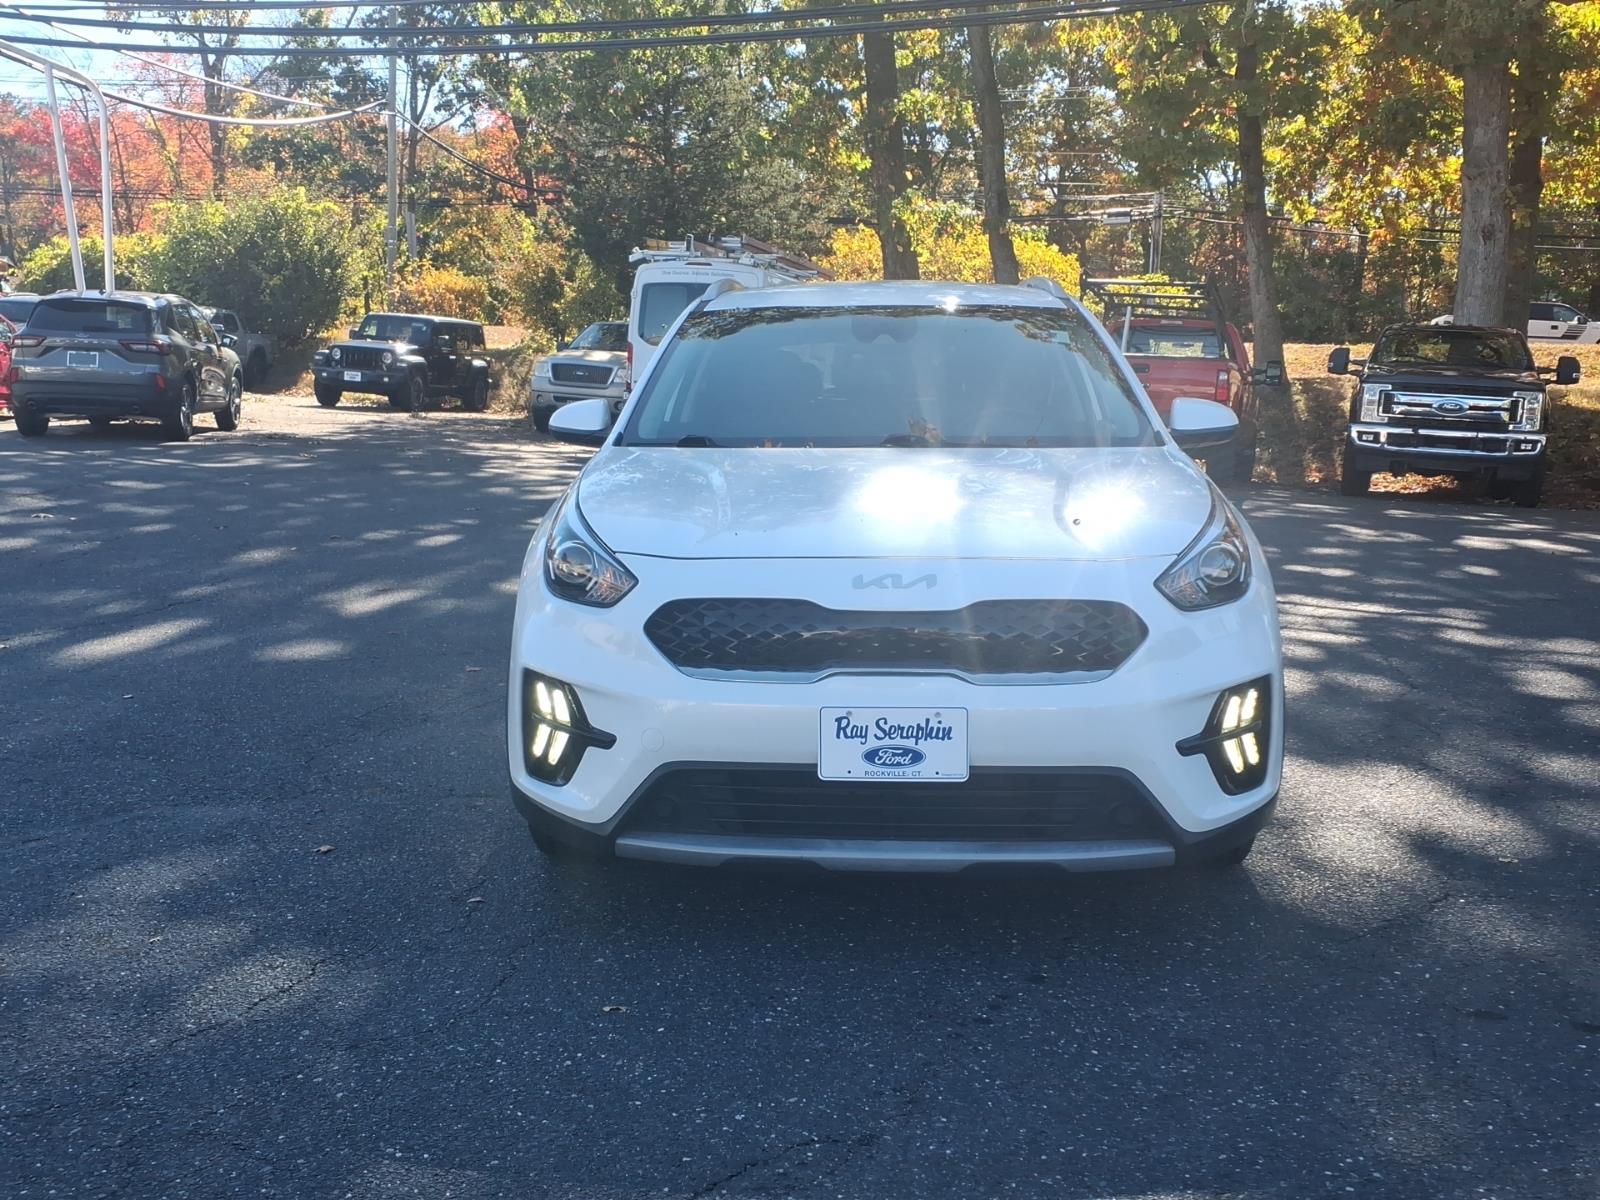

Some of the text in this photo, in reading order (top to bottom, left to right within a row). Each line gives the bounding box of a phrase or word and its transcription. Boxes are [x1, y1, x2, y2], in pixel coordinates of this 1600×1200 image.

[834, 715, 953, 746] Ray Seraphin
[874, 748, 913, 765] Ford
